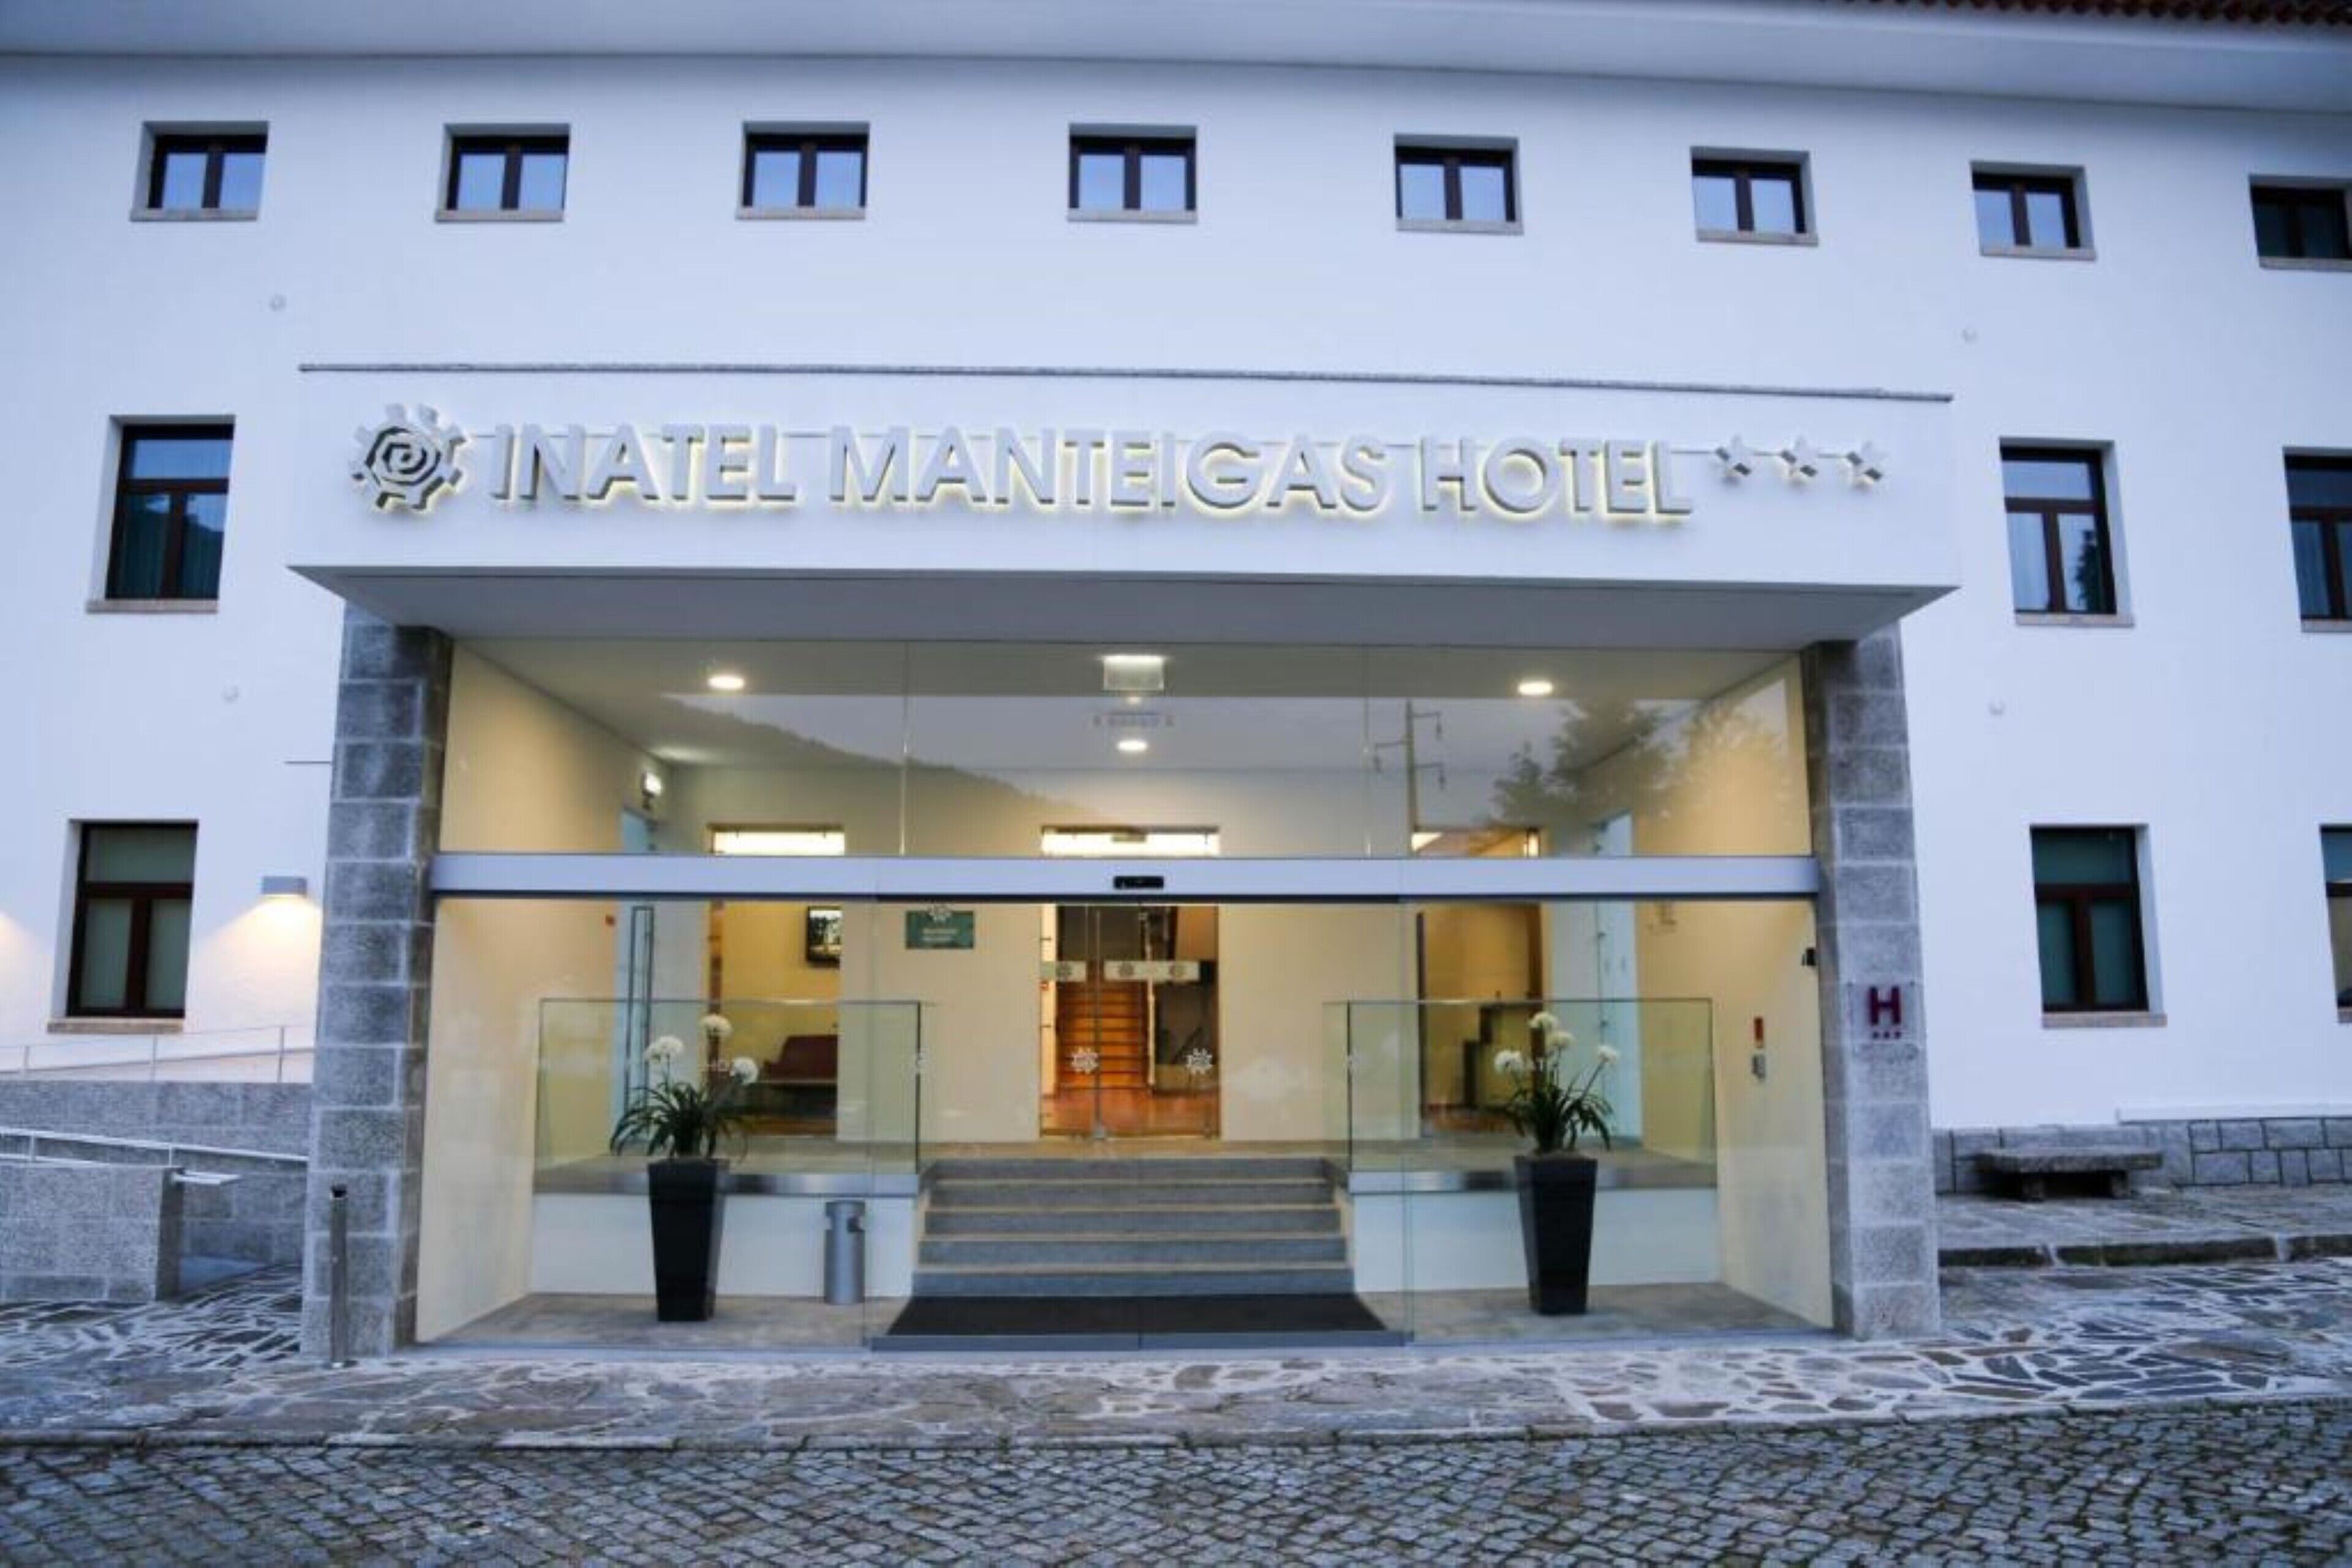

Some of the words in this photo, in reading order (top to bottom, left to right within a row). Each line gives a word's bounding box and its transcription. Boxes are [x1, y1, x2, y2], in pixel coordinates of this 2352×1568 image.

[492, 423, 797, 503] INATEL
[829, 425, 1388, 512] MANTEIGAS
[1419, 436, 1694, 516] HOTEL
[1869, 986, 1902, 1027] H
